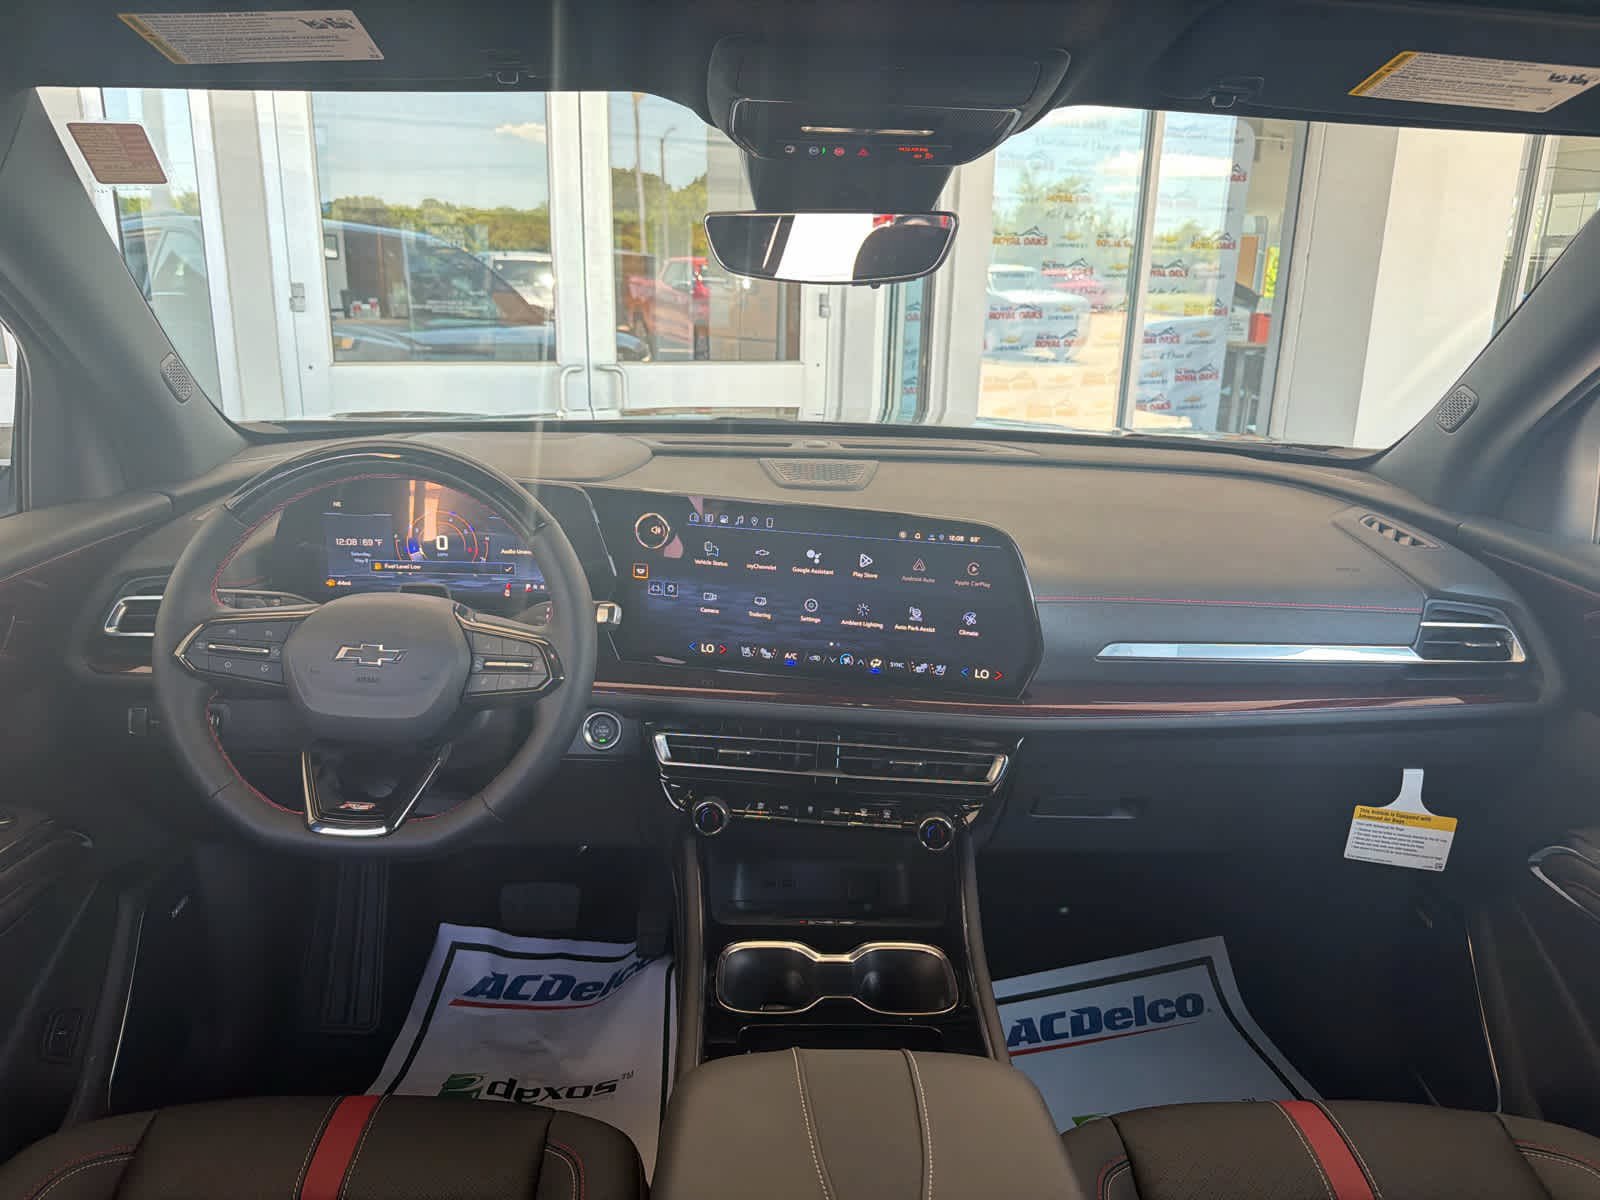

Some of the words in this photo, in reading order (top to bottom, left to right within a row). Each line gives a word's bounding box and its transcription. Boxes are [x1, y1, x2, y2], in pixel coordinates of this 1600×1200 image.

[336, 538, 358, 546] 12:08
[436, 535, 448, 551] 0
[792, 567, 810, 575] Google
[852, 571, 864, 579] Play
[800, 615, 821, 624] Settings
[841, 619, 862, 628] Ambient
[862, 622, 884, 630] Lighting
[958, 629, 979, 637] Climate
[701, 643, 715, 653] LO
[784, 652, 797, 660] A/C
[974, 669, 990, 680] LO
[463, 959, 656, 1001] ACDelco
[1006, 993, 1205, 1047] ACDelco
[486, 1078, 619, 1104] dexos
